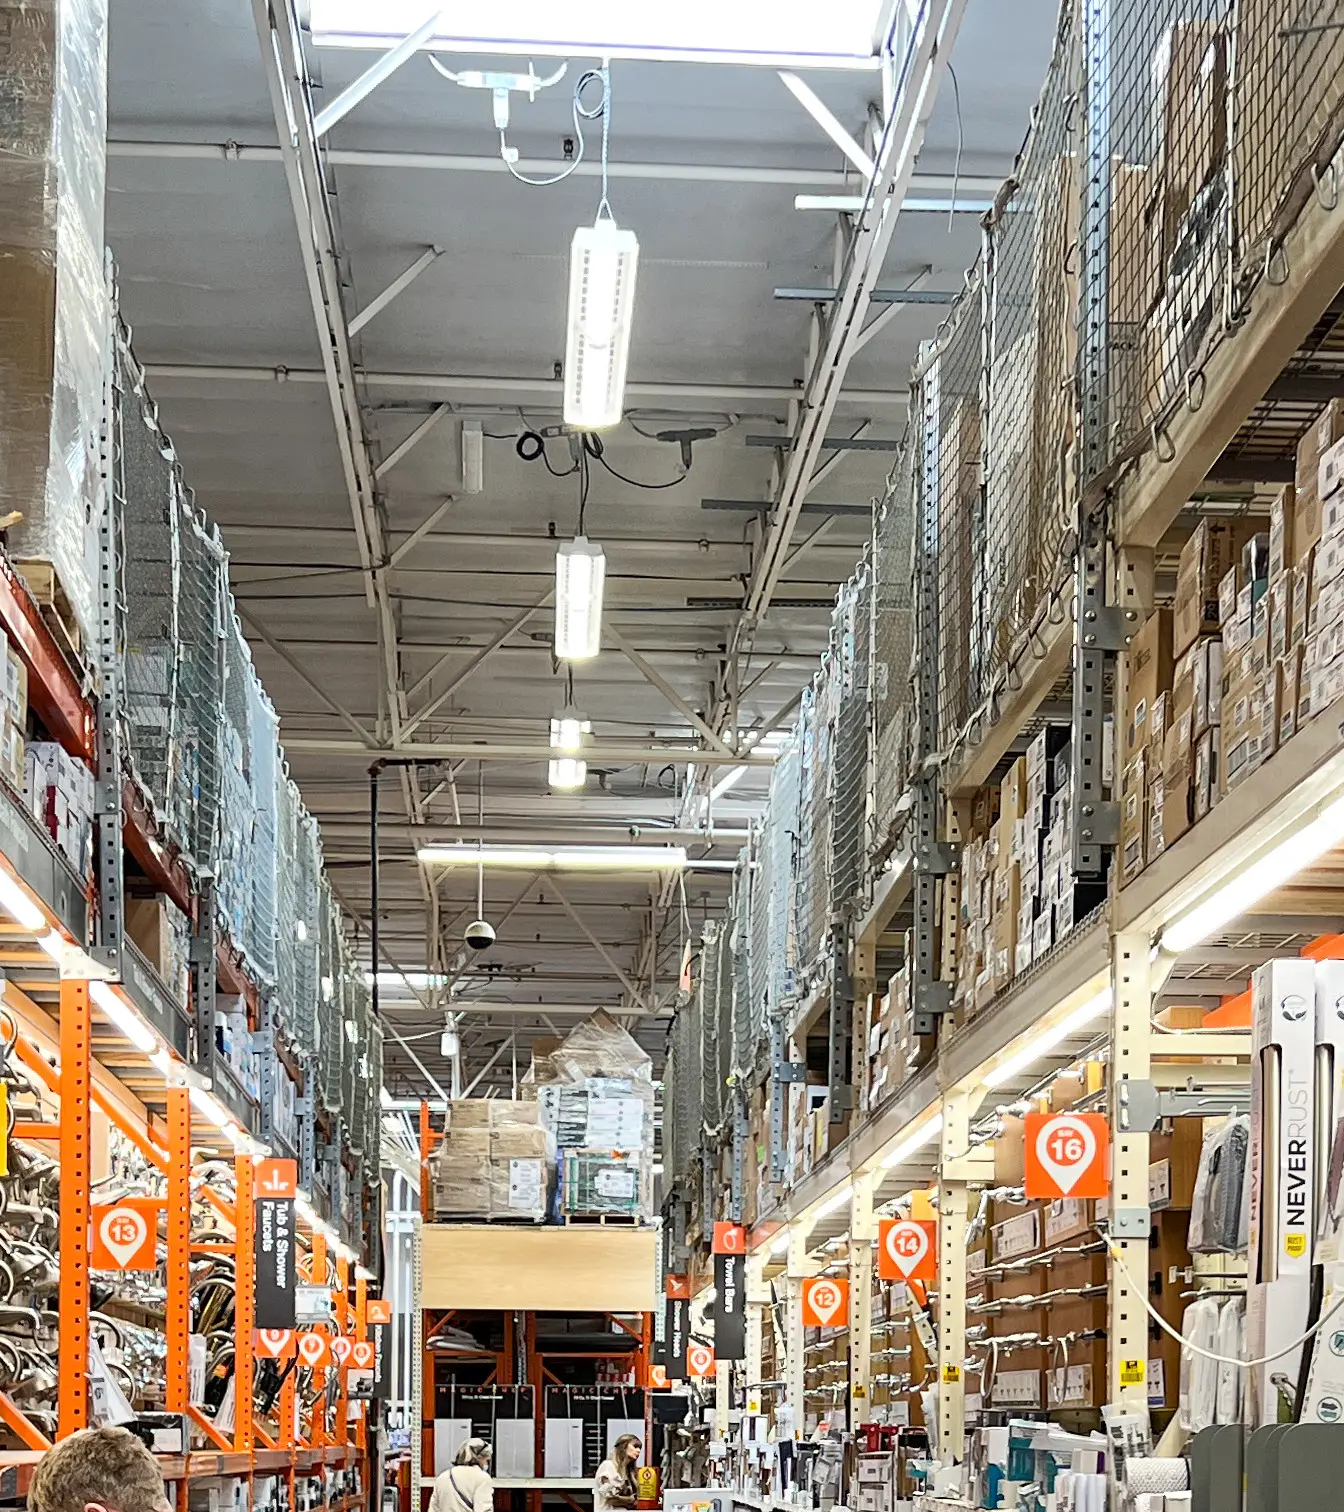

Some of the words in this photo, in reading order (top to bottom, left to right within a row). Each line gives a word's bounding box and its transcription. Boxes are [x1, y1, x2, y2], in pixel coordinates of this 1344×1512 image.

[1050, 1138, 1084, 1160] 16
[276, 1201, 290, 1225] Tub
[111, 1224, 136, 1242] 13
[262, 1201, 275, 1253] Faucets
[276, 1226, 290, 1235] &
[896, 1238, 919, 1253] 14
[276, 1235, 290, 1290] Shower
[725, 1255, 737, 1288] Towel
[816, 1293, 835, 1306] 12
